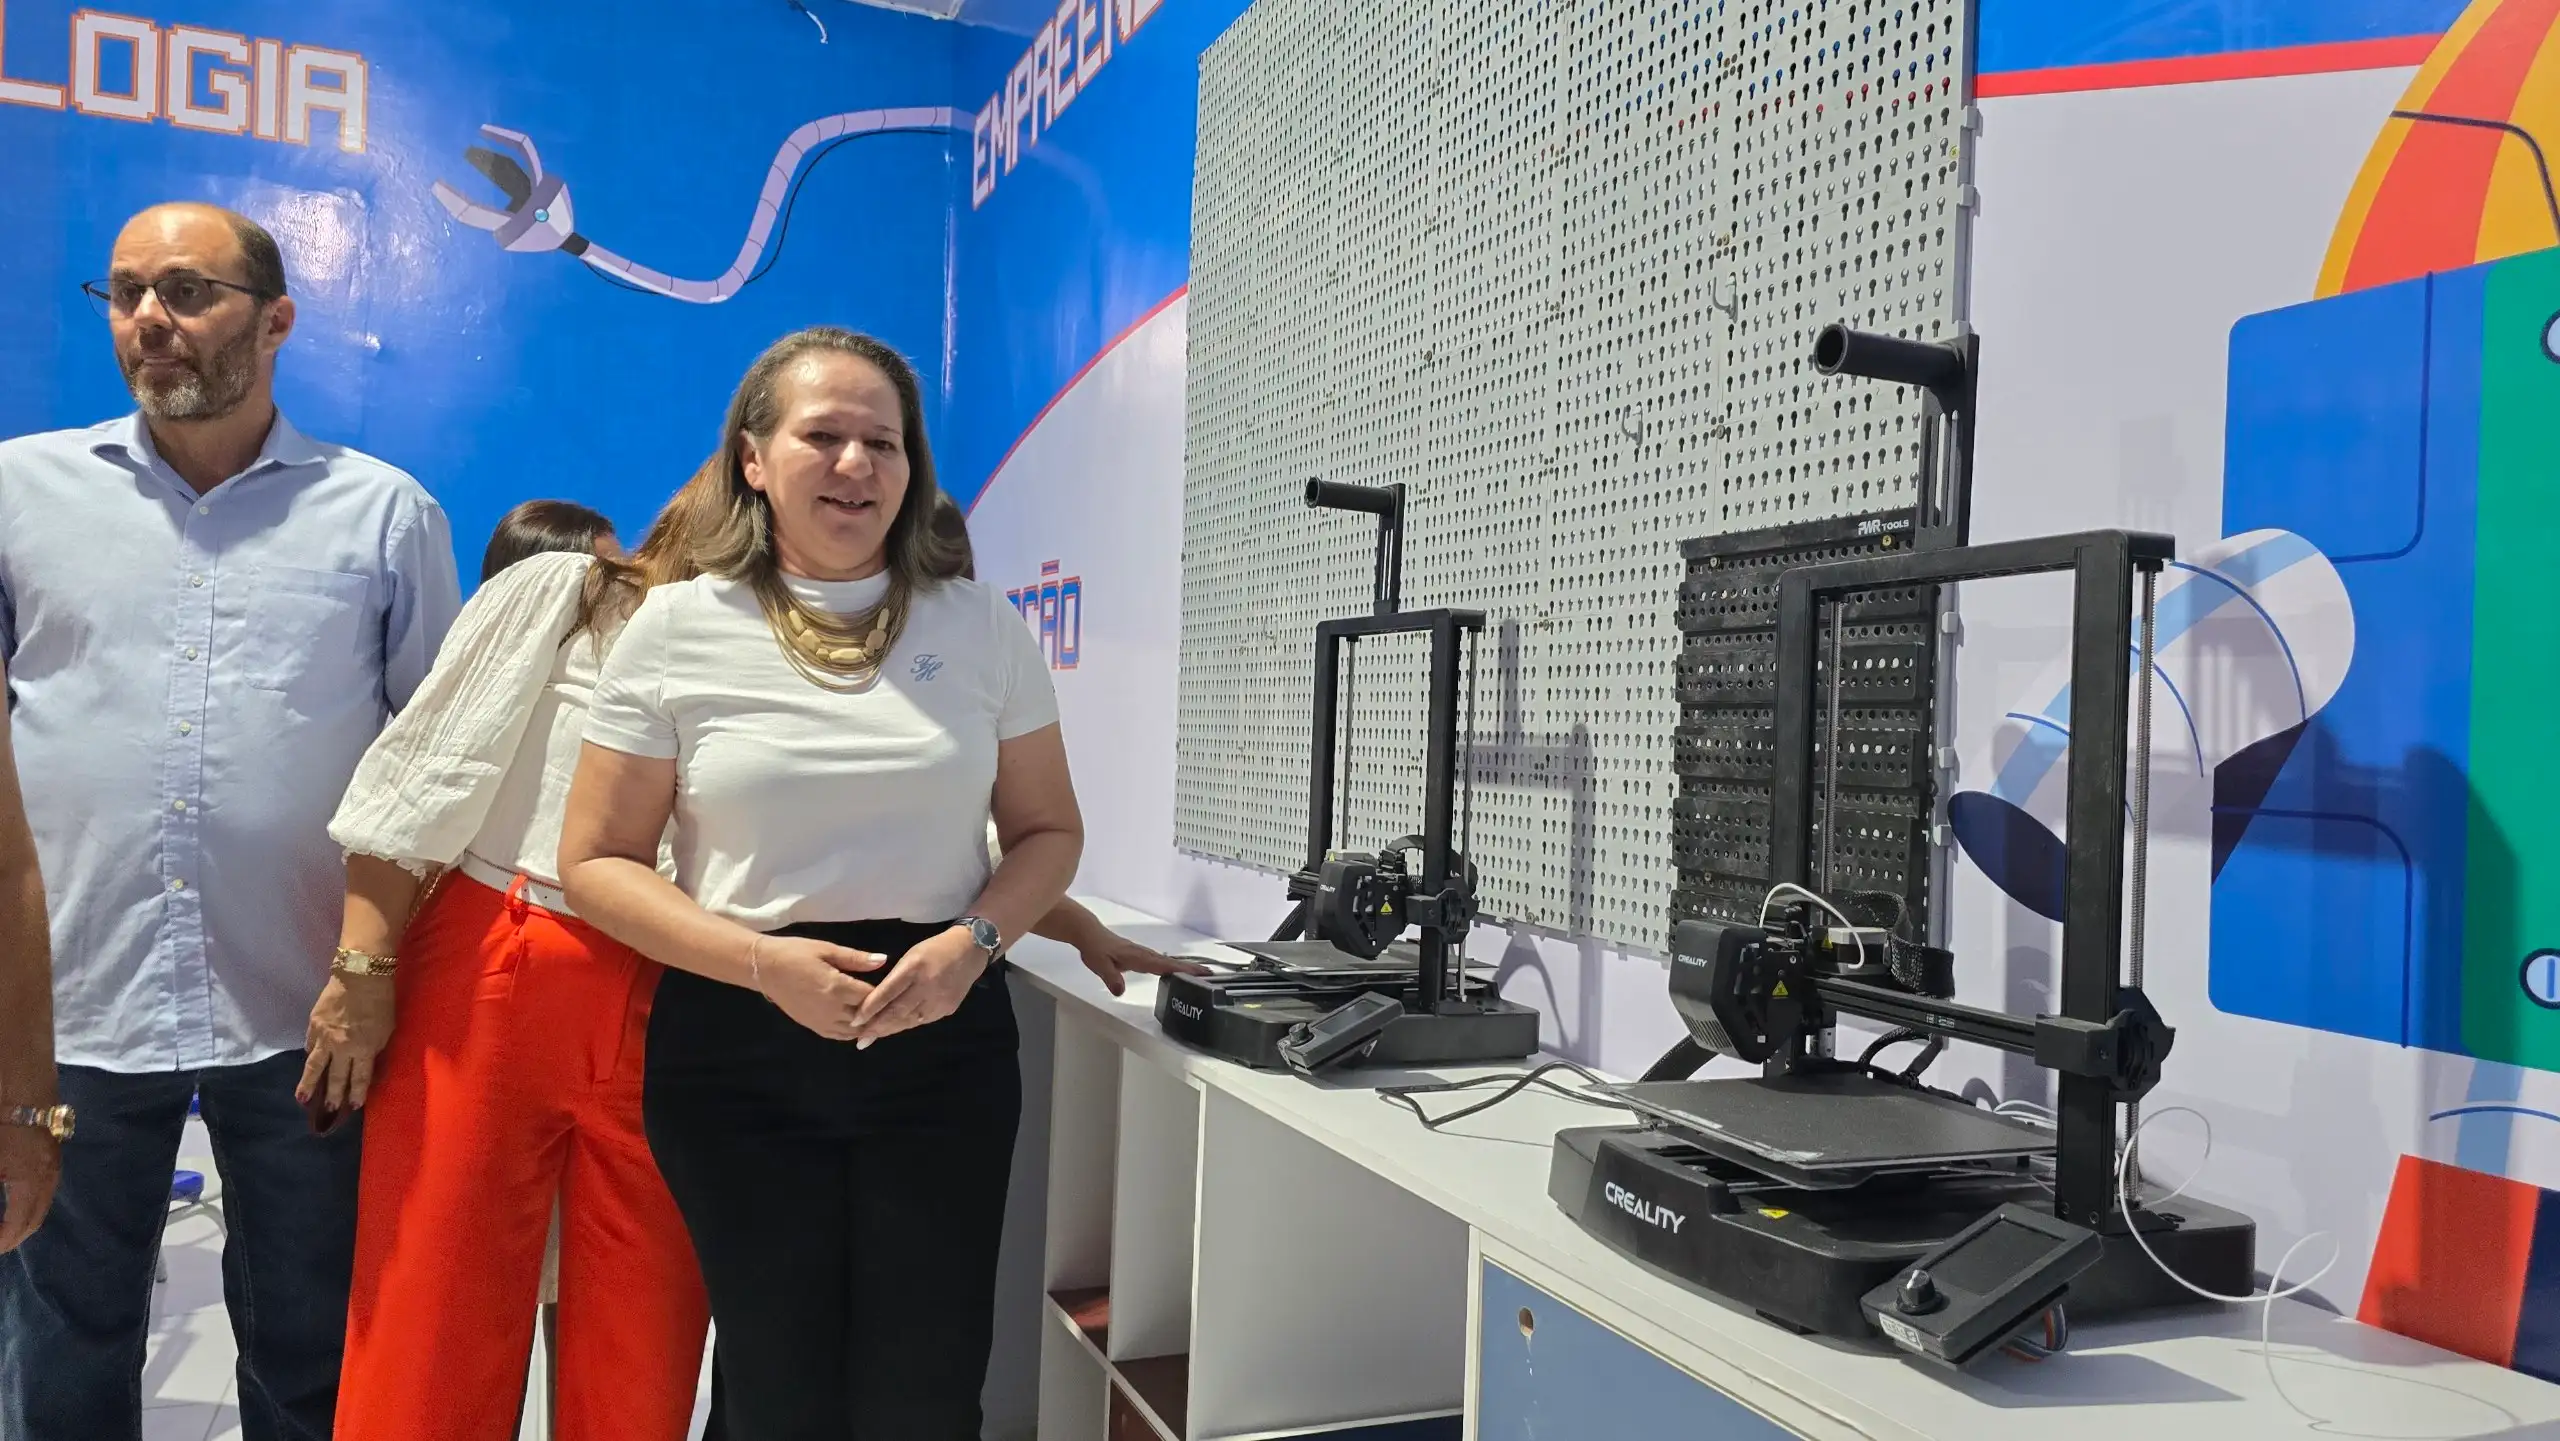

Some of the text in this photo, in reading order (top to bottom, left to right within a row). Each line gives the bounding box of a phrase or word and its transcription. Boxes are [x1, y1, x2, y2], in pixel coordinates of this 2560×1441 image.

[1857, 519, 1909, 535] PWR TOOLS
[1678, 953, 1708, 968] CREALITY
[1171, 997, 1203, 1020] CREALITY
[1604, 1181, 1687, 1234] CREALITY
